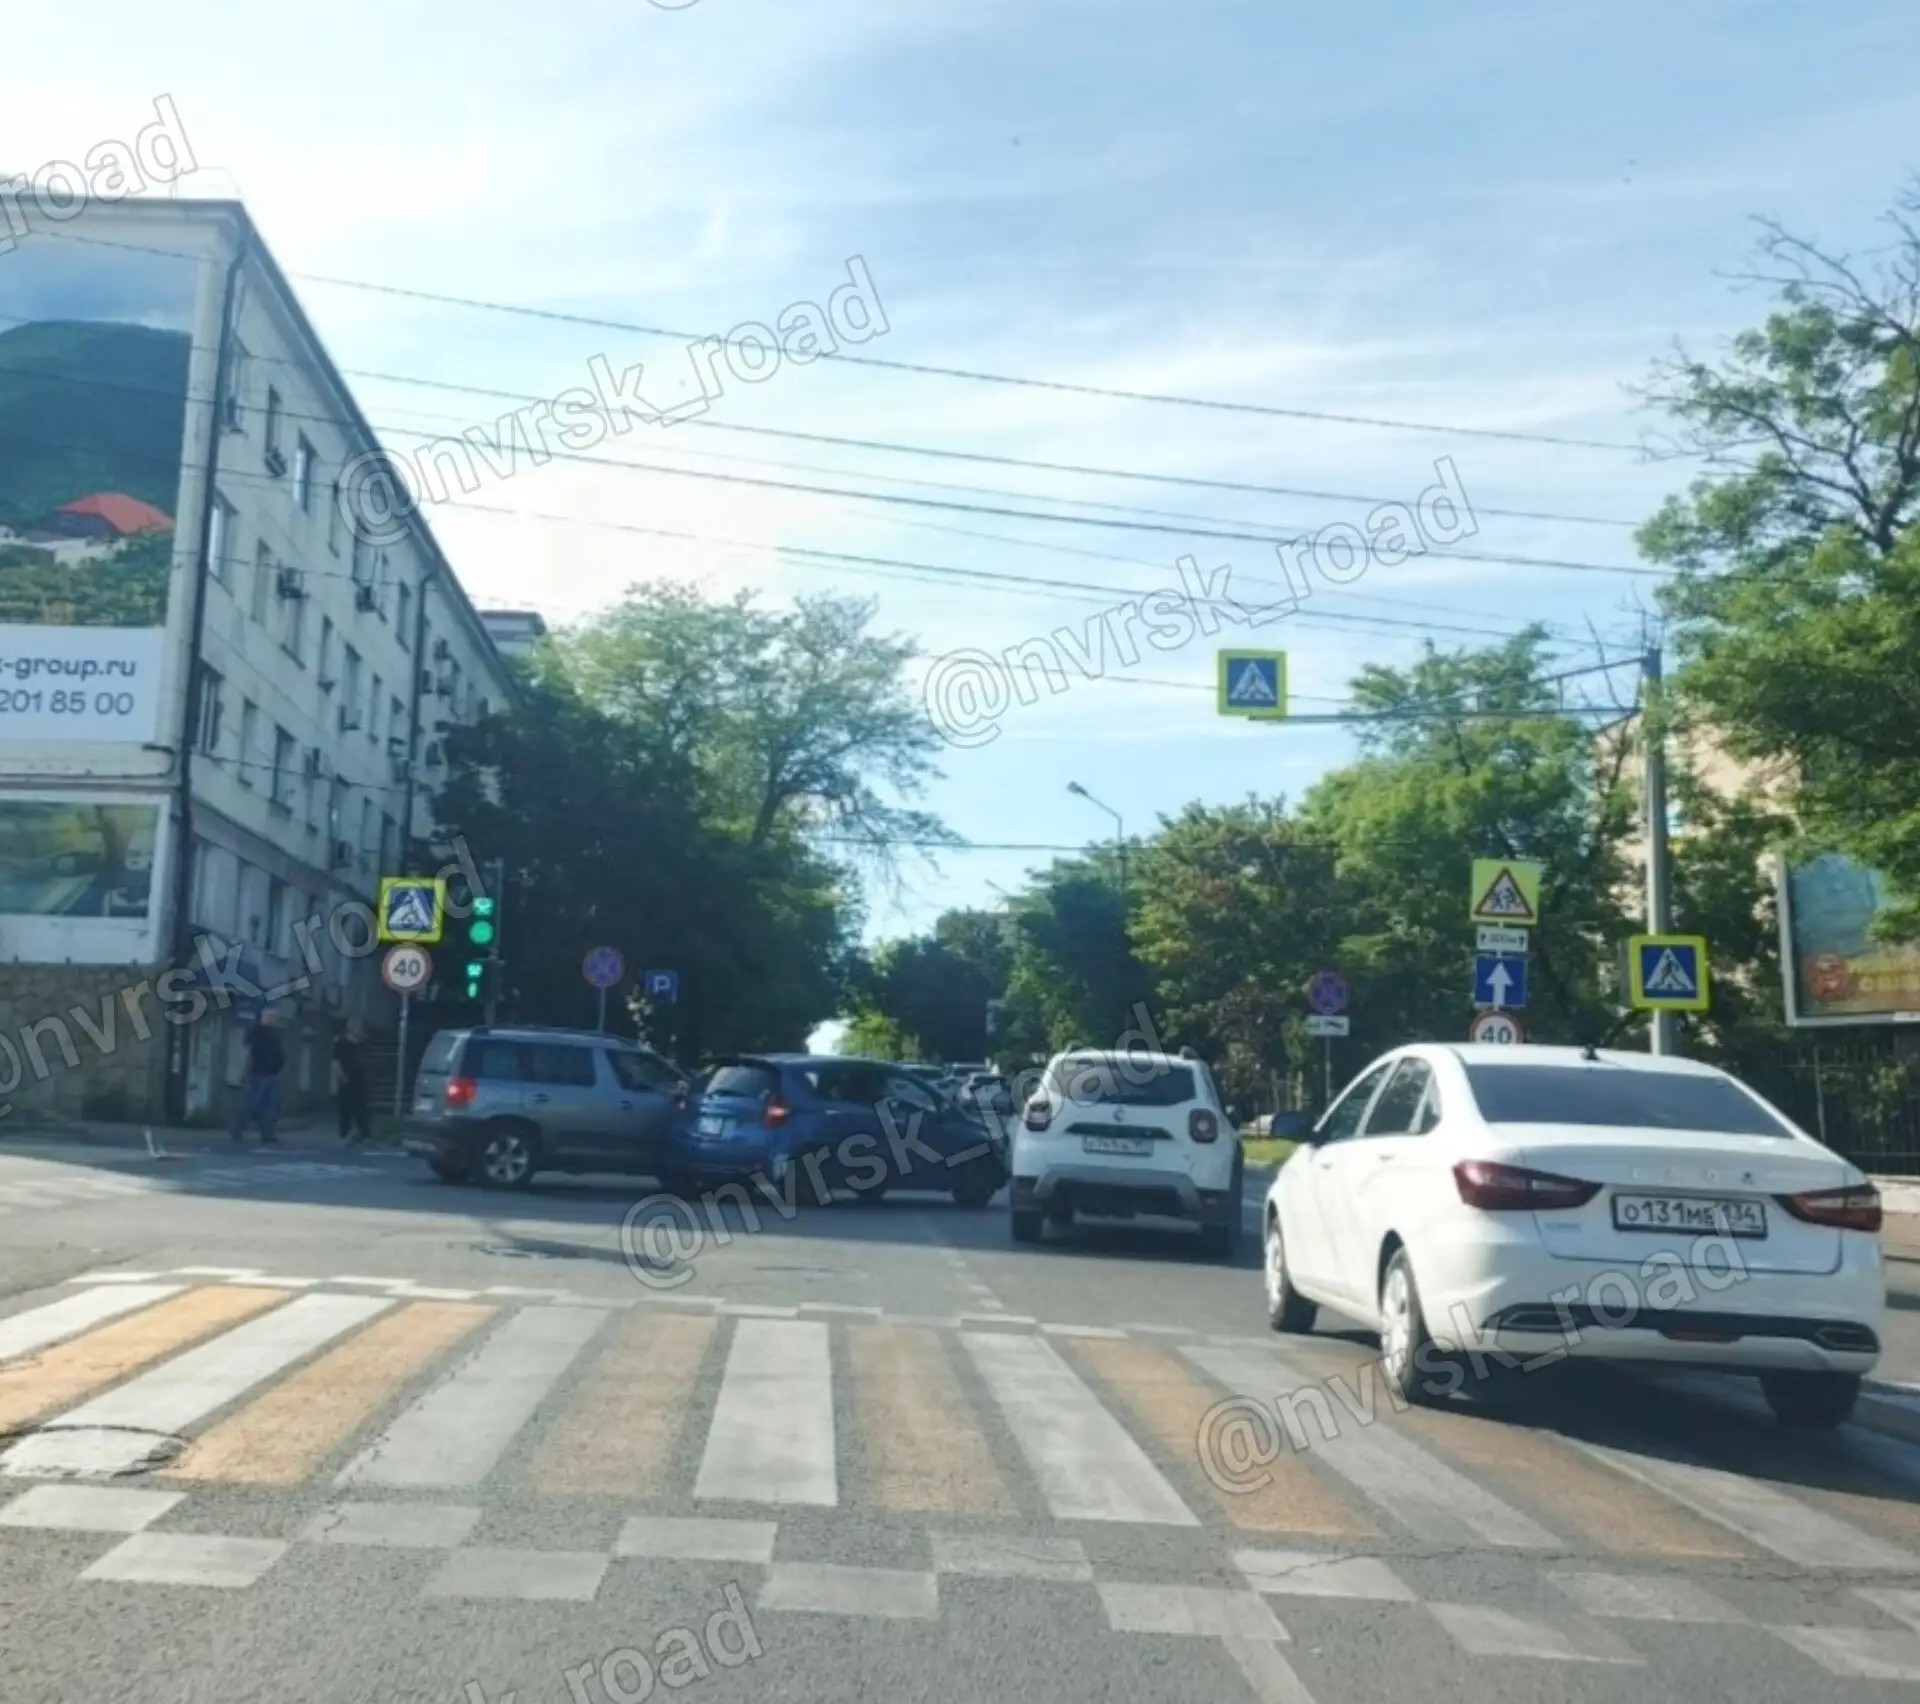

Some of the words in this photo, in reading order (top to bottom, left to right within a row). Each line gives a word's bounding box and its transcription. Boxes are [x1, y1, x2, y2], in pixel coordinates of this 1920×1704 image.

[0, 657, 137, 681] -group.ru
[51, 689, 87, 714] 85
[94, 691, 135, 715] 00
[393, 958, 420, 977] 40
[654, 975, 671, 993] P
[1480, 1025, 1513, 1044] 40
